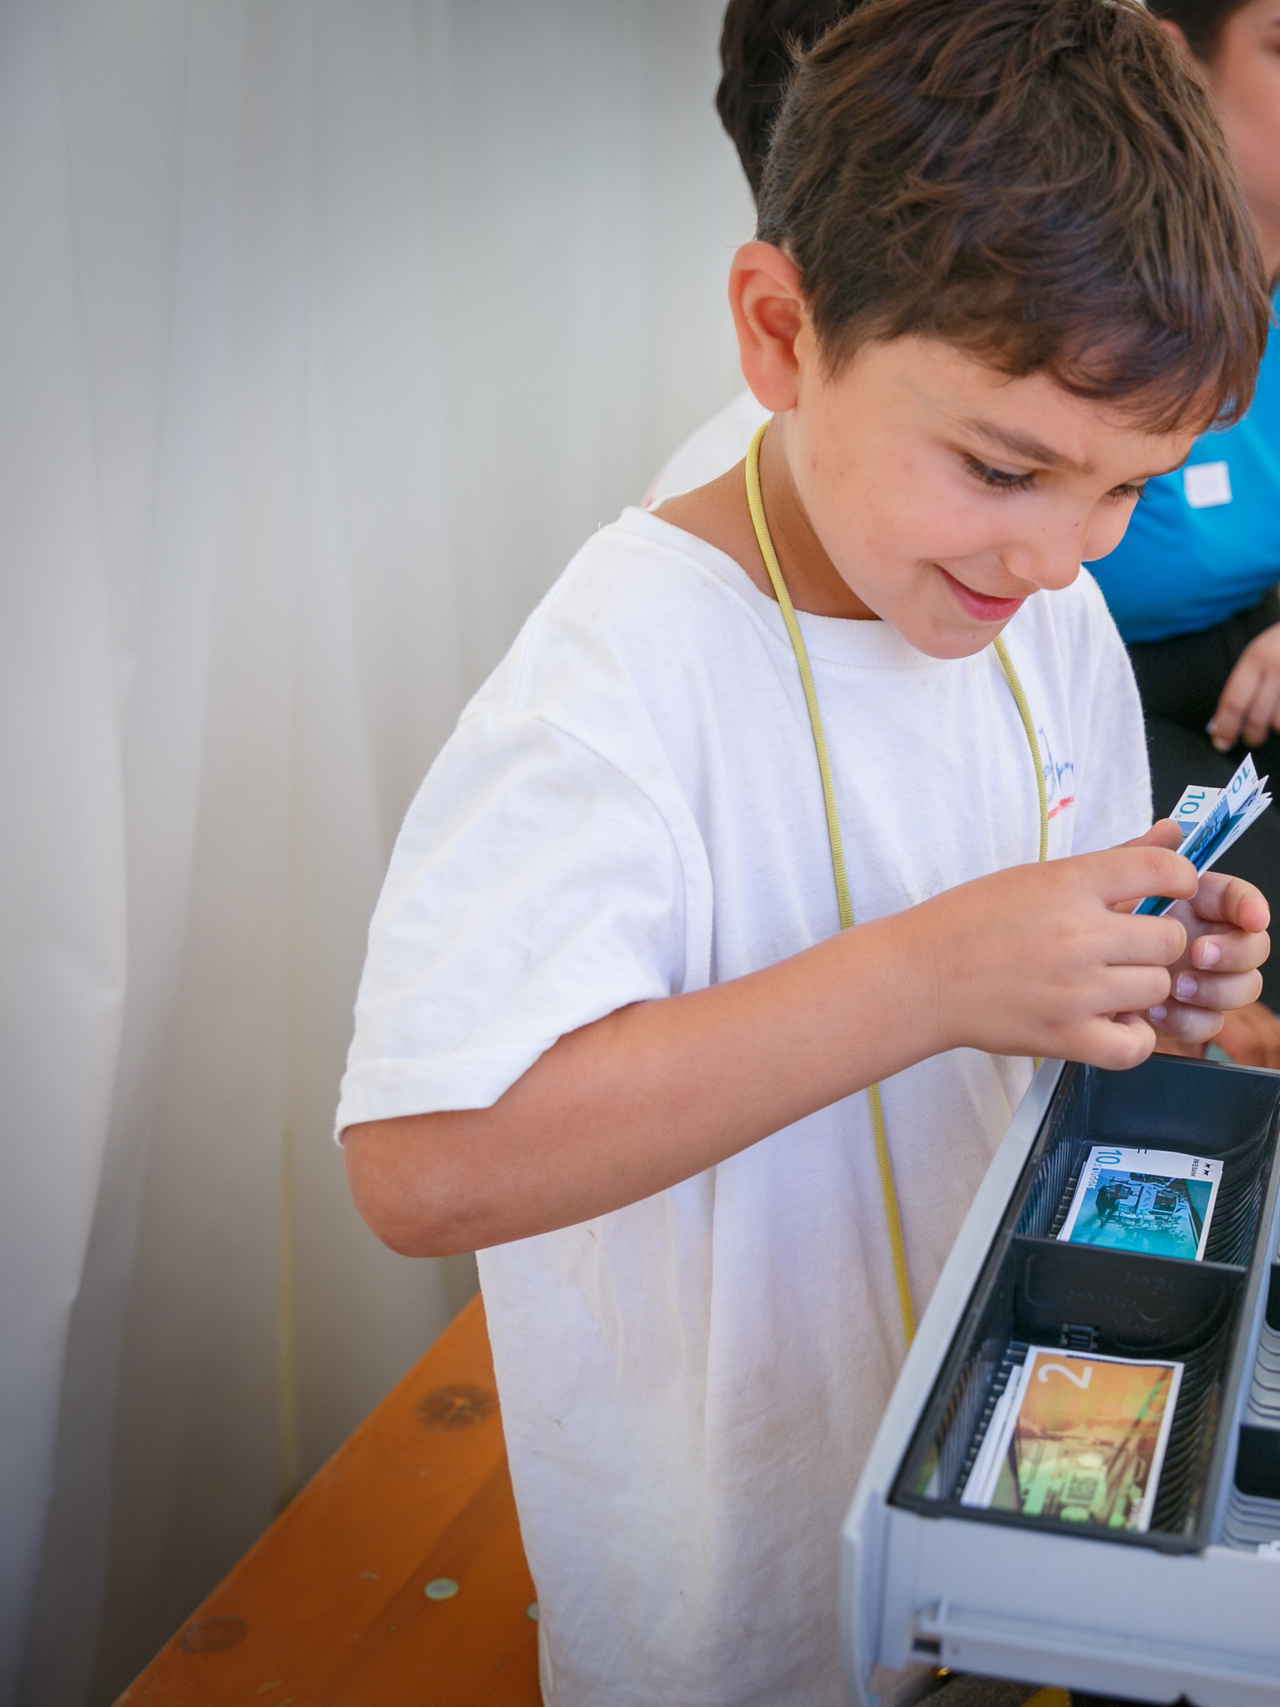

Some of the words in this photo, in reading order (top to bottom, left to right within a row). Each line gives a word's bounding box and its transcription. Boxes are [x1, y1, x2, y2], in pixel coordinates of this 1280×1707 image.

[1231, 766, 1250, 795] 10
[1179, 791, 1206, 815] 10
[1095, 1149, 1122, 1165] 10
[1037, 1362, 1093, 1390] 2
